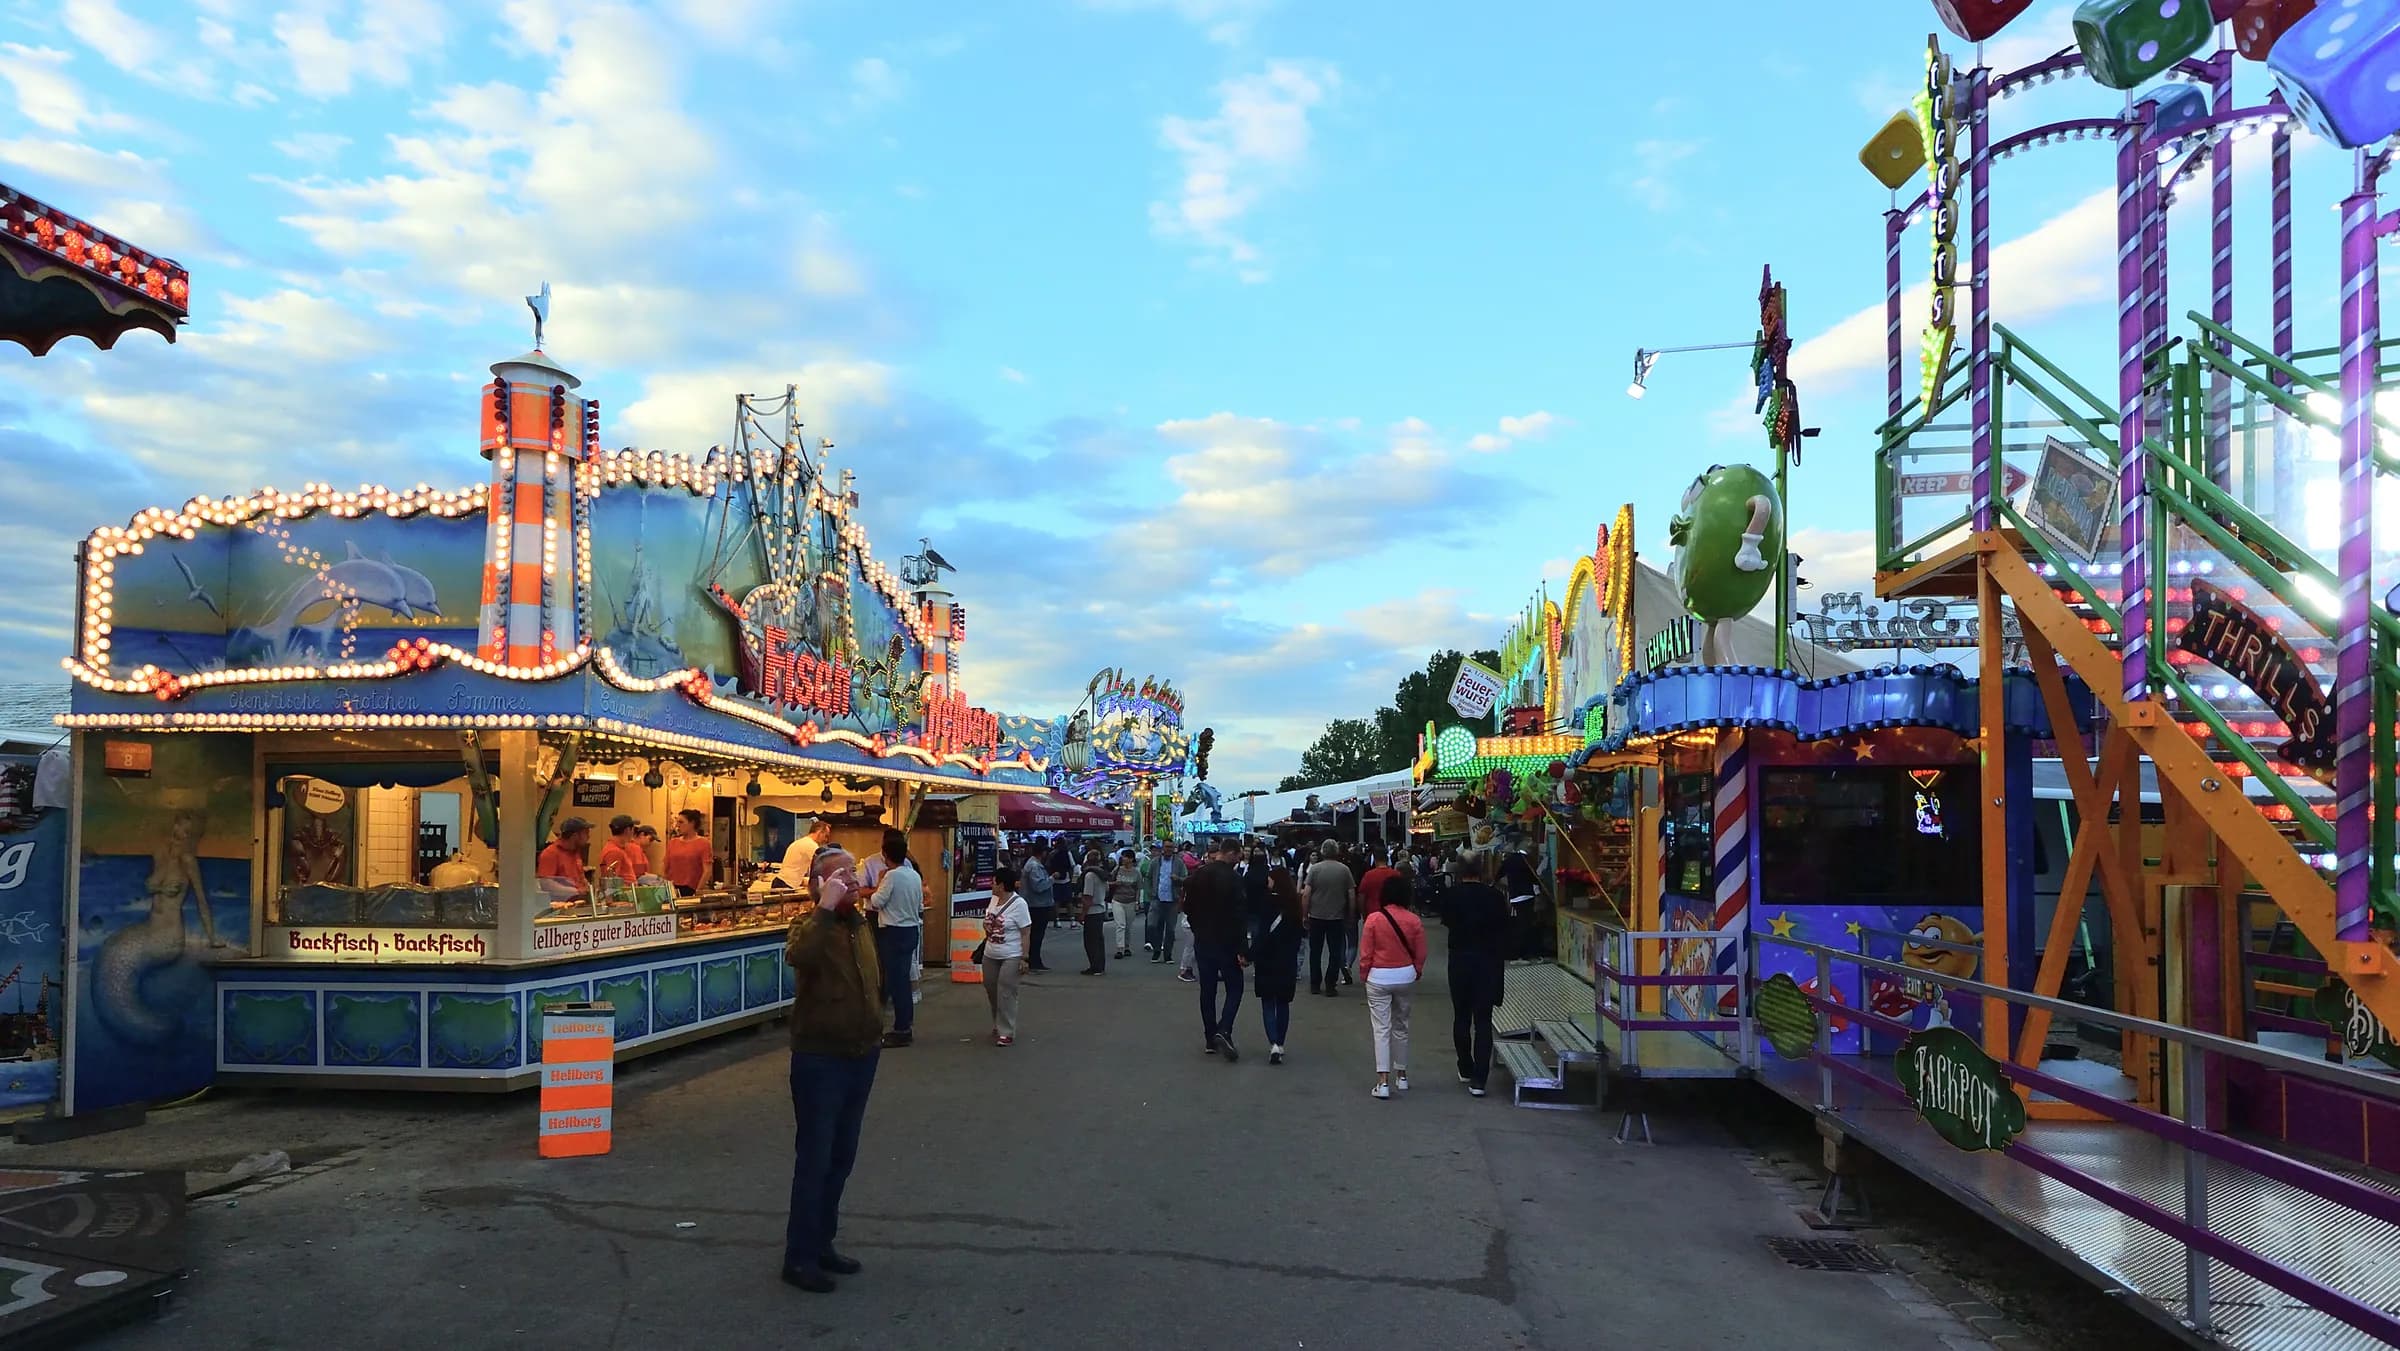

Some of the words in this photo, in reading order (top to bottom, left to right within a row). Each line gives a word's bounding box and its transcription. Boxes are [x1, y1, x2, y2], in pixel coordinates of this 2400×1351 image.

[1903, 476, 1947, 494] KEEP
[1458, 672, 1496, 697] Feuer-
[2203, 608, 2320, 741] THRILLS
[1456, 684, 1490, 708] wurst
[123, 753, 134, 767] 8
[289, 930, 379, 956] Backfisch
[393, 932, 486, 957] Backfisch
[592, 923, 622, 949] guter
[623, 915, 673, 939] Backfisch
[552, 1022, 606, 1034] Hellberg
[550, 1068, 605, 1082] Hellberg
[1914, 1045, 1995, 1149] JACKPOT
[548, 1115, 602, 1130] Hellberg
